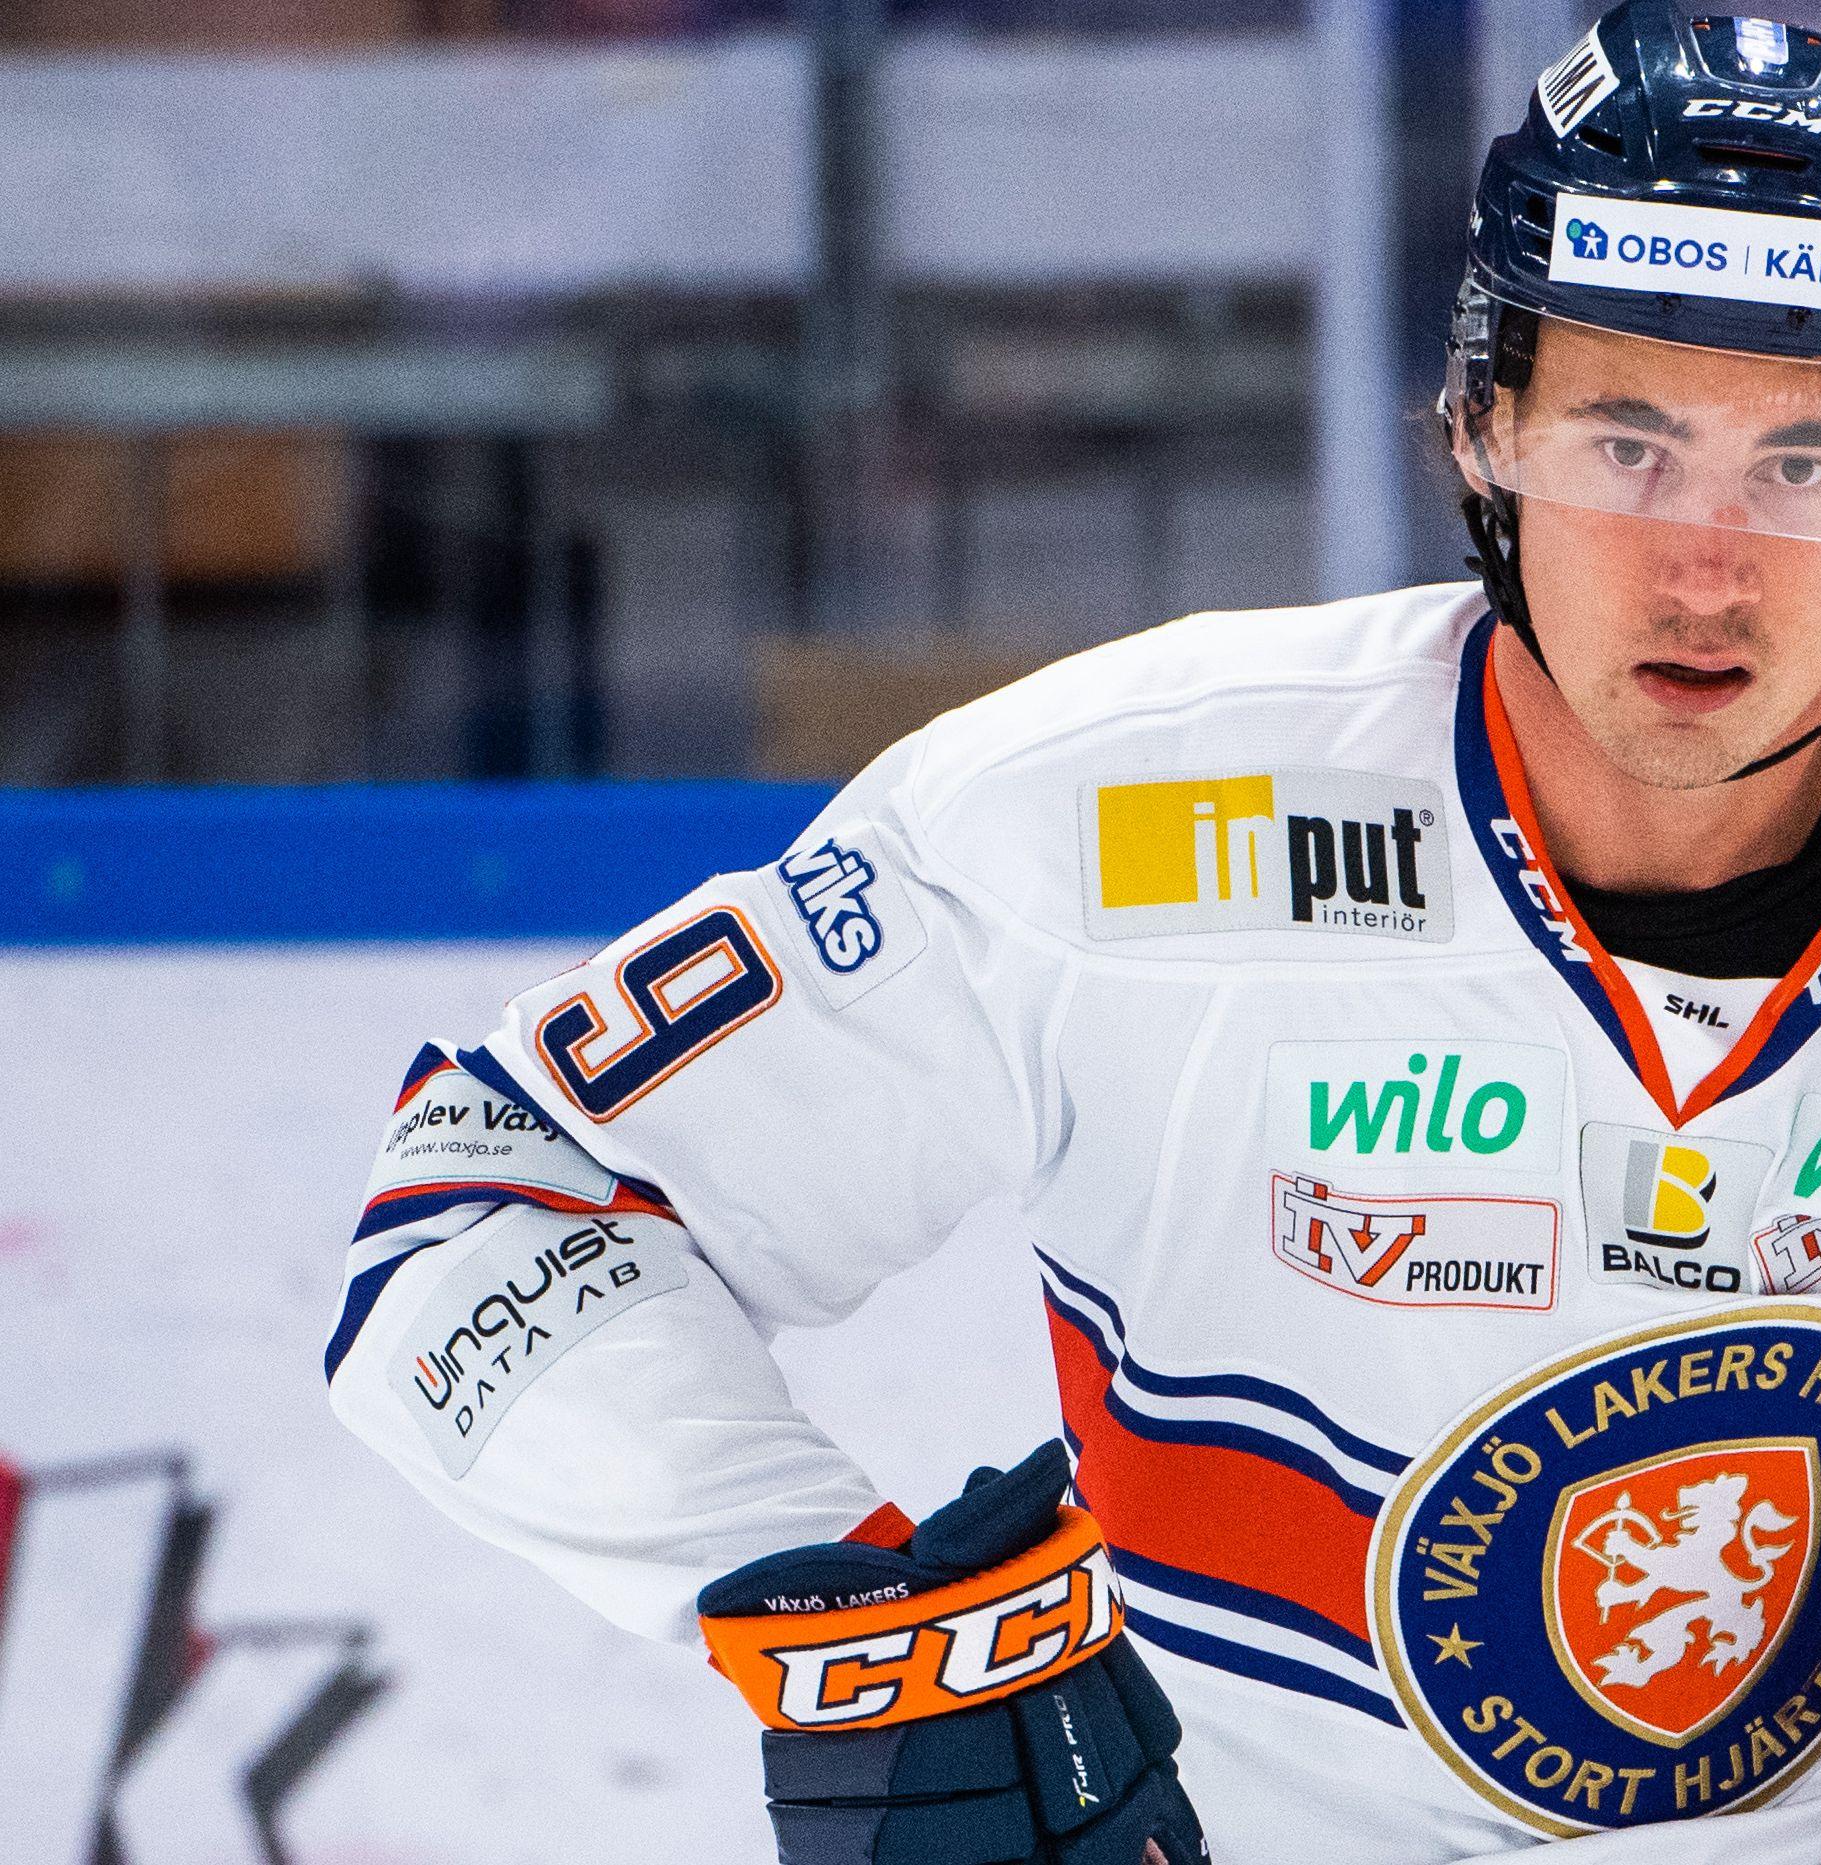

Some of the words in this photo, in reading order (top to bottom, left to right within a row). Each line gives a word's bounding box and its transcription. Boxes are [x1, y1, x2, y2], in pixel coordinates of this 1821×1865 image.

[1618, 234, 1728, 271] OBOS
[1490, 814, 1593, 963] CCM
[1322, 904, 1427, 933] interiör
[1663, 993, 1729, 1029] SHL
[1310, 1053, 1527, 1154] wilo
[400, 1140, 512, 1160] www.vaxjo.se
[1406, 1260, 1544, 1296] PRODUKT
[1602, 1243, 1741, 1293] BALCO
[414, 1217, 635, 1411] Winquist
[1416, 1438, 1543, 1602] VÄXJÖ
[1545, 1342, 1794, 1449] LAKERS
[764, 1592, 825, 1613] VÄXJÖ
[836, 1582, 910, 1608] LAKERS
[1462, 1695, 1657, 1815] STORT
